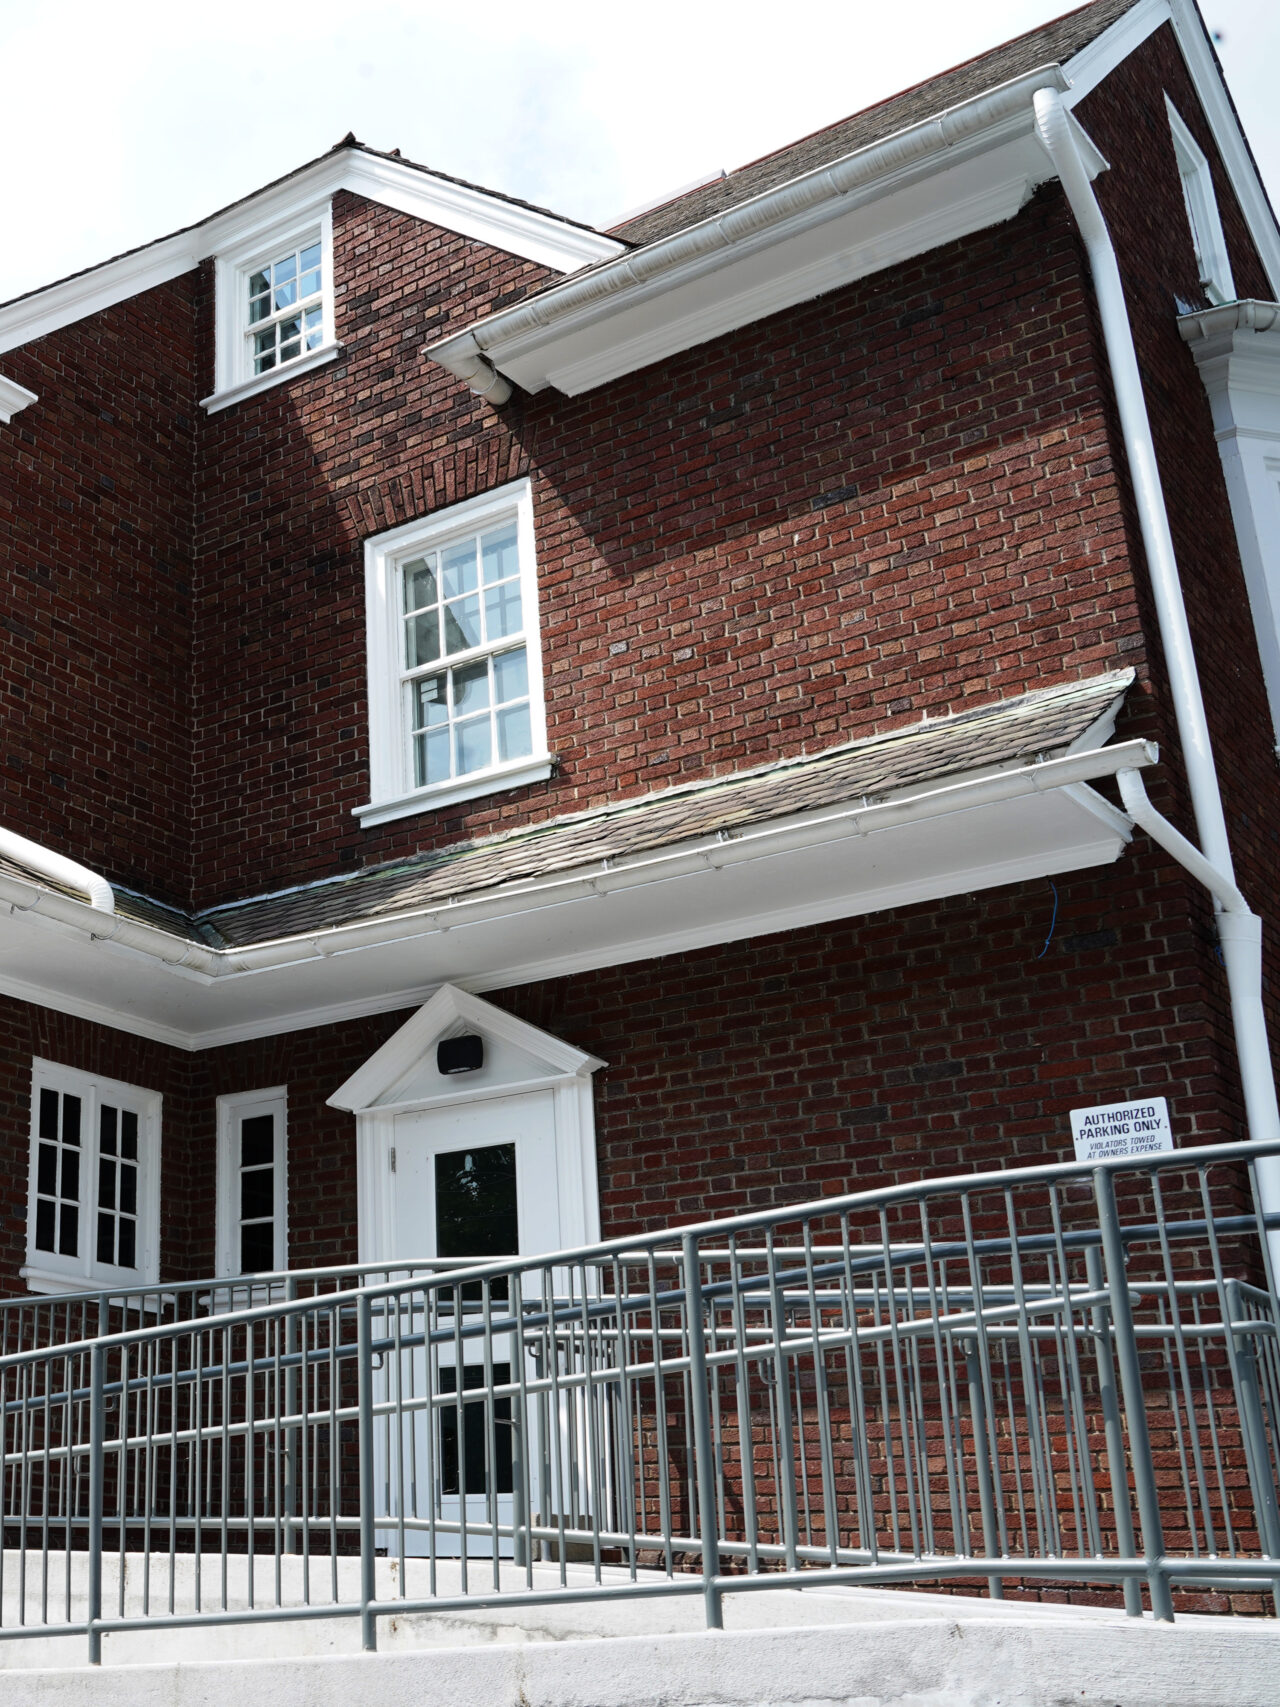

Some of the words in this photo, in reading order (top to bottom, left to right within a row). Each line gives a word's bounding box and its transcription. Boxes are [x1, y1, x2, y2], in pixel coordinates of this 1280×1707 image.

[1084, 1106, 1155, 1126] AUTHORIZED
[1080, 1123, 1130, 1140] PARKING
[1134, 1118, 1161, 1132] ONLY
[1087, 1151, 1096, 1159] AT
[1099, 1147, 1128, 1158] OWNERS
[1131, 1142, 1162, 1153] EXPENSE
[1090, 1138, 1127, 1150] VIOLATORS
[1130, 1135, 1155, 1144] TOWED
